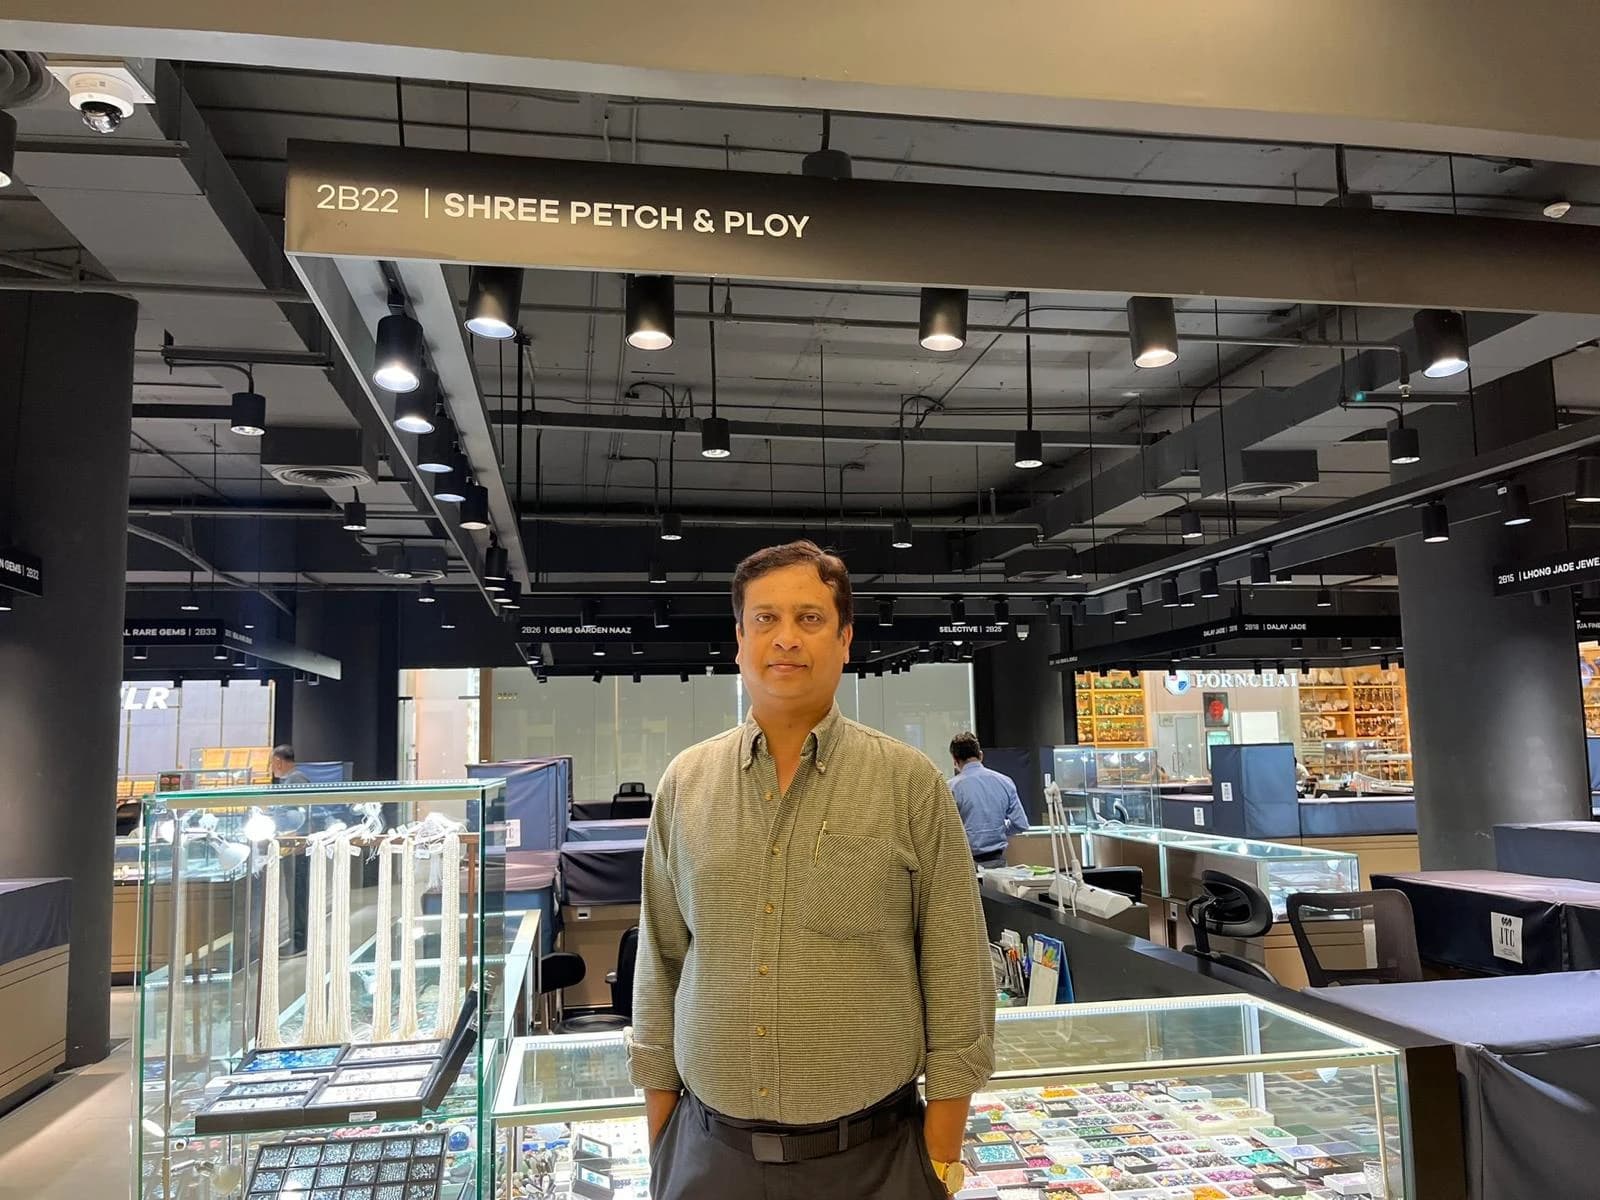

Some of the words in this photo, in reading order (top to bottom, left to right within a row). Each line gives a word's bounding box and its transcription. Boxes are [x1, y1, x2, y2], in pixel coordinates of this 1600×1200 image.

[316, 184, 399, 213] 2B22
[444, 192, 560, 223] SHREE
[570, 201, 683, 231] PETCH
[693, 208, 715, 233] &
[724, 210, 810, 238] PLOY
[1522, 567, 1551, 580] LHONG
[1552, 562, 1574, 574] JADE
[132, 628, 157, 636] RARE
[159, 628, 186, 636] GEMS
[549, 626, 573, 634] GEMS
[574, 626, 608, 634] GARDEN
[609, 626, 632, 634] NAAZ
[1196, 672, 1298, 688] PORNCHAI
[121, 687, 170, 710] LR
